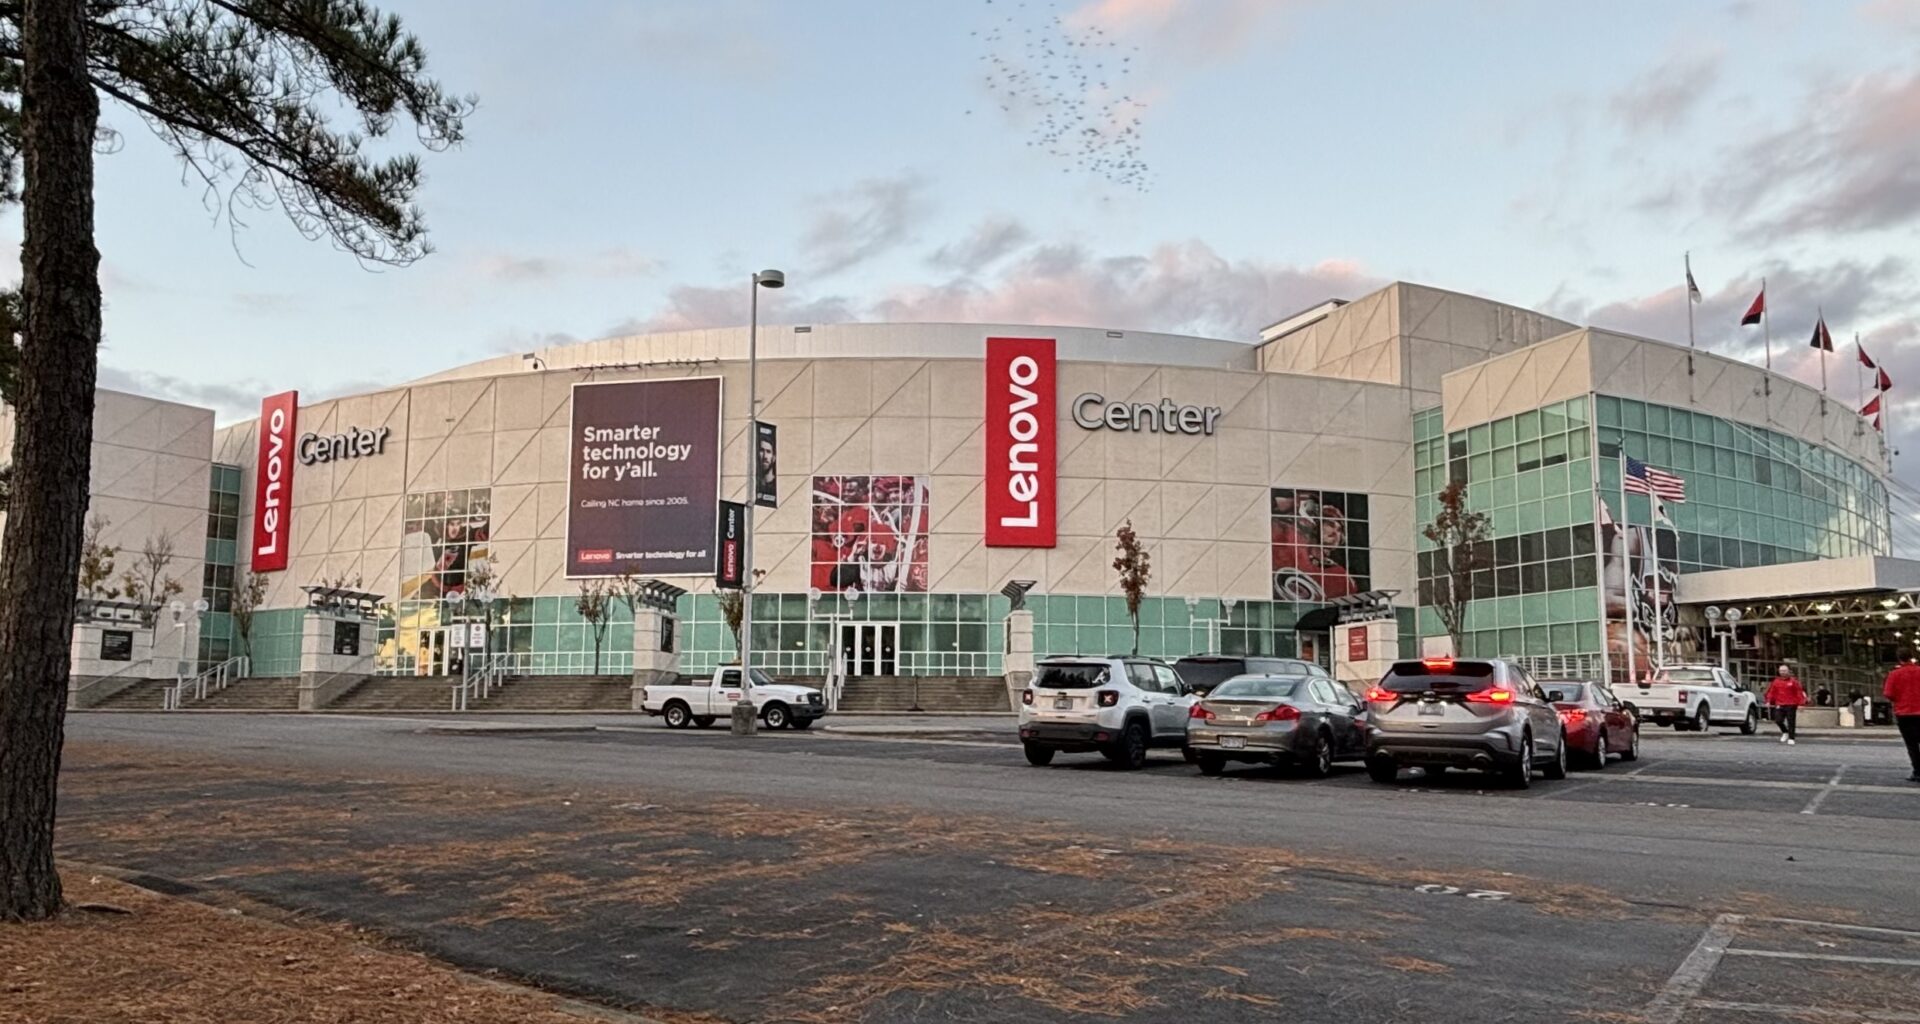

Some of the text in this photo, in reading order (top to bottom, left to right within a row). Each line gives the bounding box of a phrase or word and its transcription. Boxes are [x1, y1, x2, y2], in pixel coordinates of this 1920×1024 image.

[1072, 392, 1221, 435] Center
[297, 426, 391, 466] Center
[583, 424, 660, 442] Smarter
[1000, 355, 1039, 528] Lenovo
[583, 442, 692, 461] technology
[258, 408, 285, 555] Lenovo
[582, 460, 658, 481] for y'all.
[580, 499, 607, 509] Calling
[608, 498, 621, 507] NC
[621, 498, 644, 507] home
[645, 497, 665, 506] since
[580, 549, 707, 561] Lenovo Smarter technology for all
[726, 508, 735, 578] Lenovo Center
